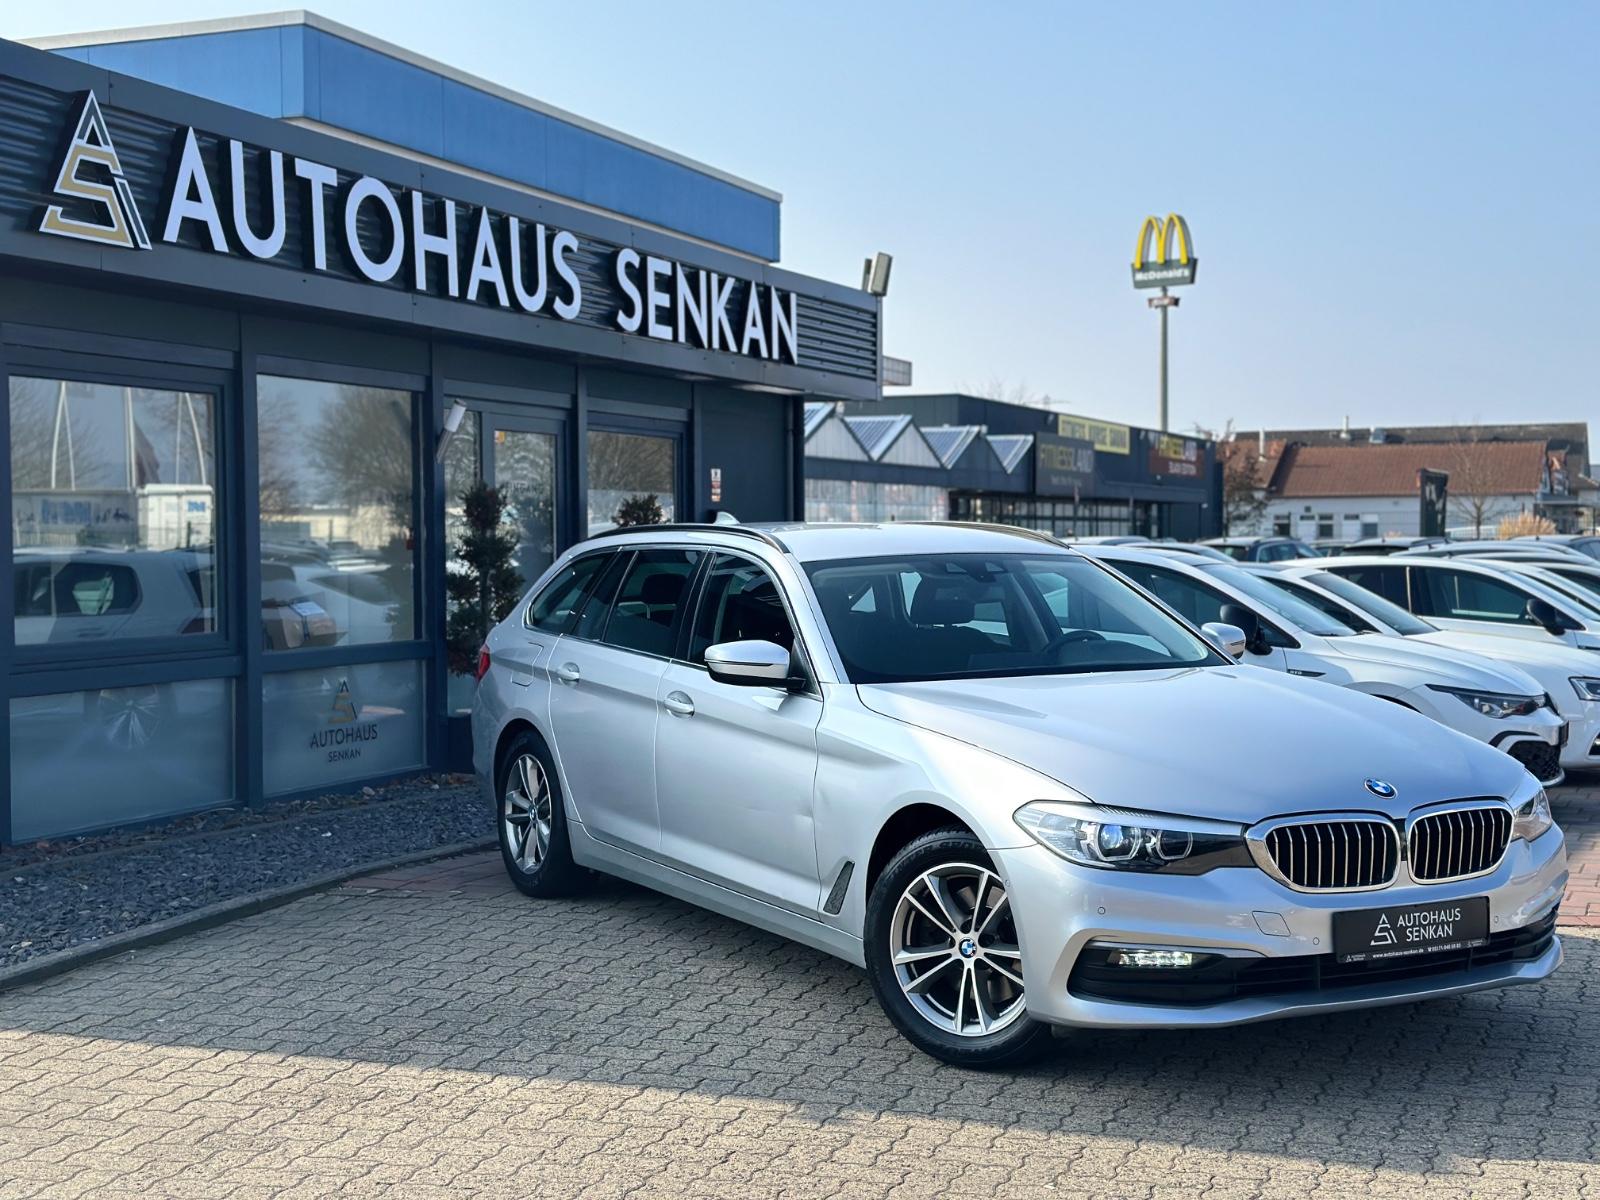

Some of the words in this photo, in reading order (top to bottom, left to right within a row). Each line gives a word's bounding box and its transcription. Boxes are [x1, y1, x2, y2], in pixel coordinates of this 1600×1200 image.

[162, 126, 583, 320] AUTOHAUS
[616, 248, 799, 365] SENKAN
[310, 724, 378, 748] AUTOHAUS
[328, 749, 360, 762] SENKAN
[1398, 908, 1461, 928] AUTOHAUS
[1406, 924, 1453, 942] SENKAN
